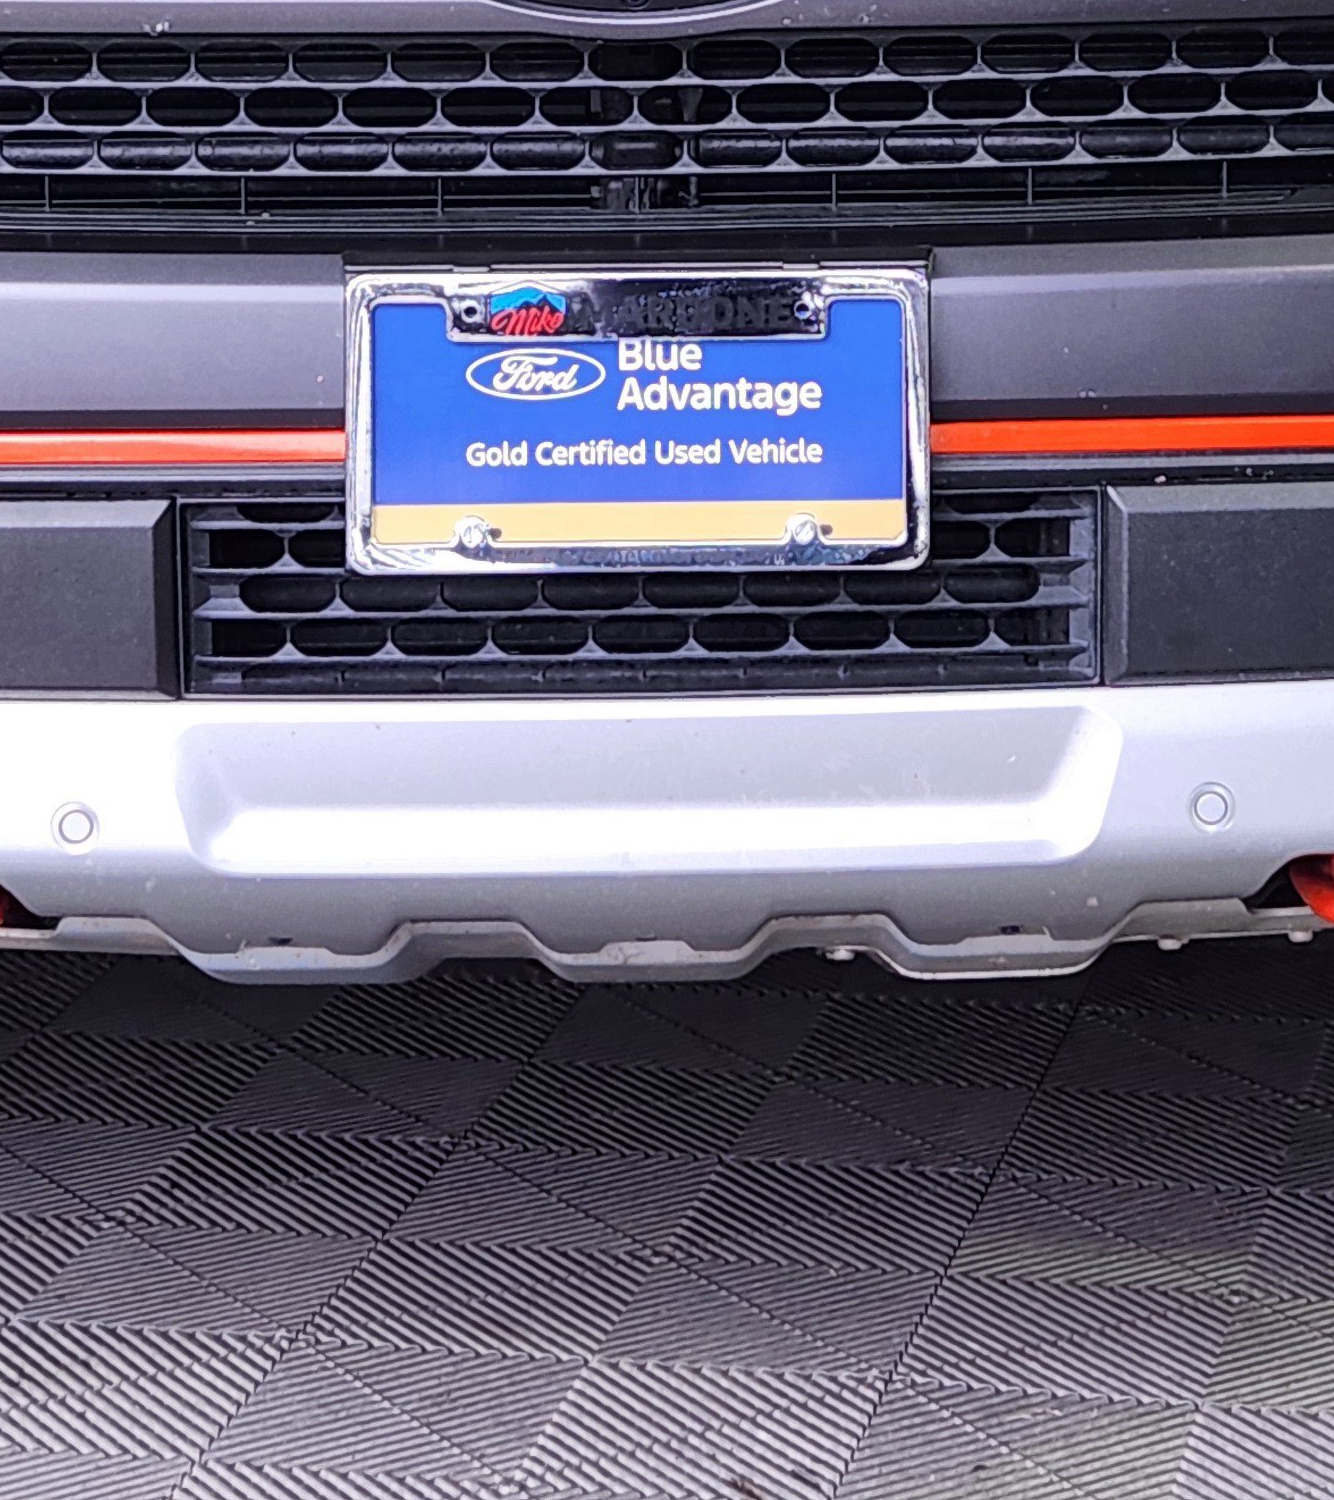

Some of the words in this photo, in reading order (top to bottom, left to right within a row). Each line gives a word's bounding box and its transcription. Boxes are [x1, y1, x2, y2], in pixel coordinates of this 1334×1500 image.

[490, 306, 564, 337] Mike
[618, 338, 703, 372] Blue
[492, 355, 578, 392] Ford
[617, 374, 823, 417] Advantage
[466, 439, 528, 467] Gold
[534, 438, 647, 467] Certified
[654, 438, 721, 465] Used
[727, 437, 823, 465] Vehicle
